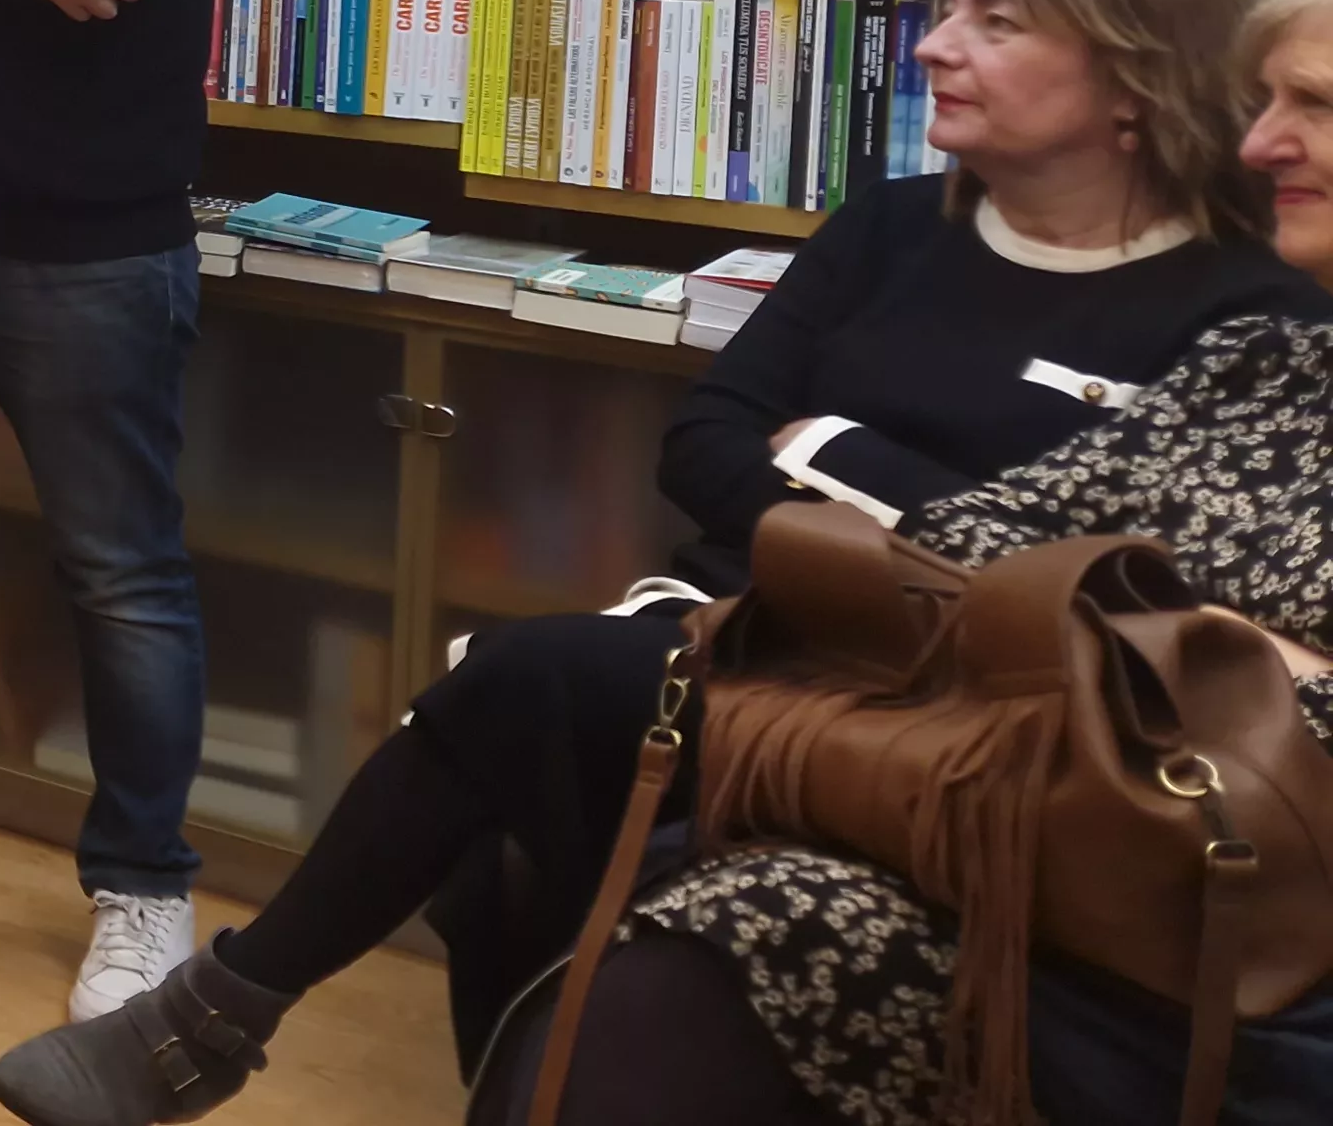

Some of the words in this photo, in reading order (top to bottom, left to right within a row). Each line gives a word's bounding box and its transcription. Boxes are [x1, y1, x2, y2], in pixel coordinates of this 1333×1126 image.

[549, 6, 566, 46] ESPINOSA
[737, 36, 749, 54] TUS
[778, 14, 792, 65] Altamente
[736, 56, 748, 100] SOMBRAS
[777, 69, 789, 109] sensible
[507, 96, 523, 136] ESPINOSA
[526, 98, 541, 136] ESPINOSA
[679, 76, 694, 132] DIGNIDAD
[505, 138, 522, 168] ALBERT
[523, 138, 539, 170] ALBERT
